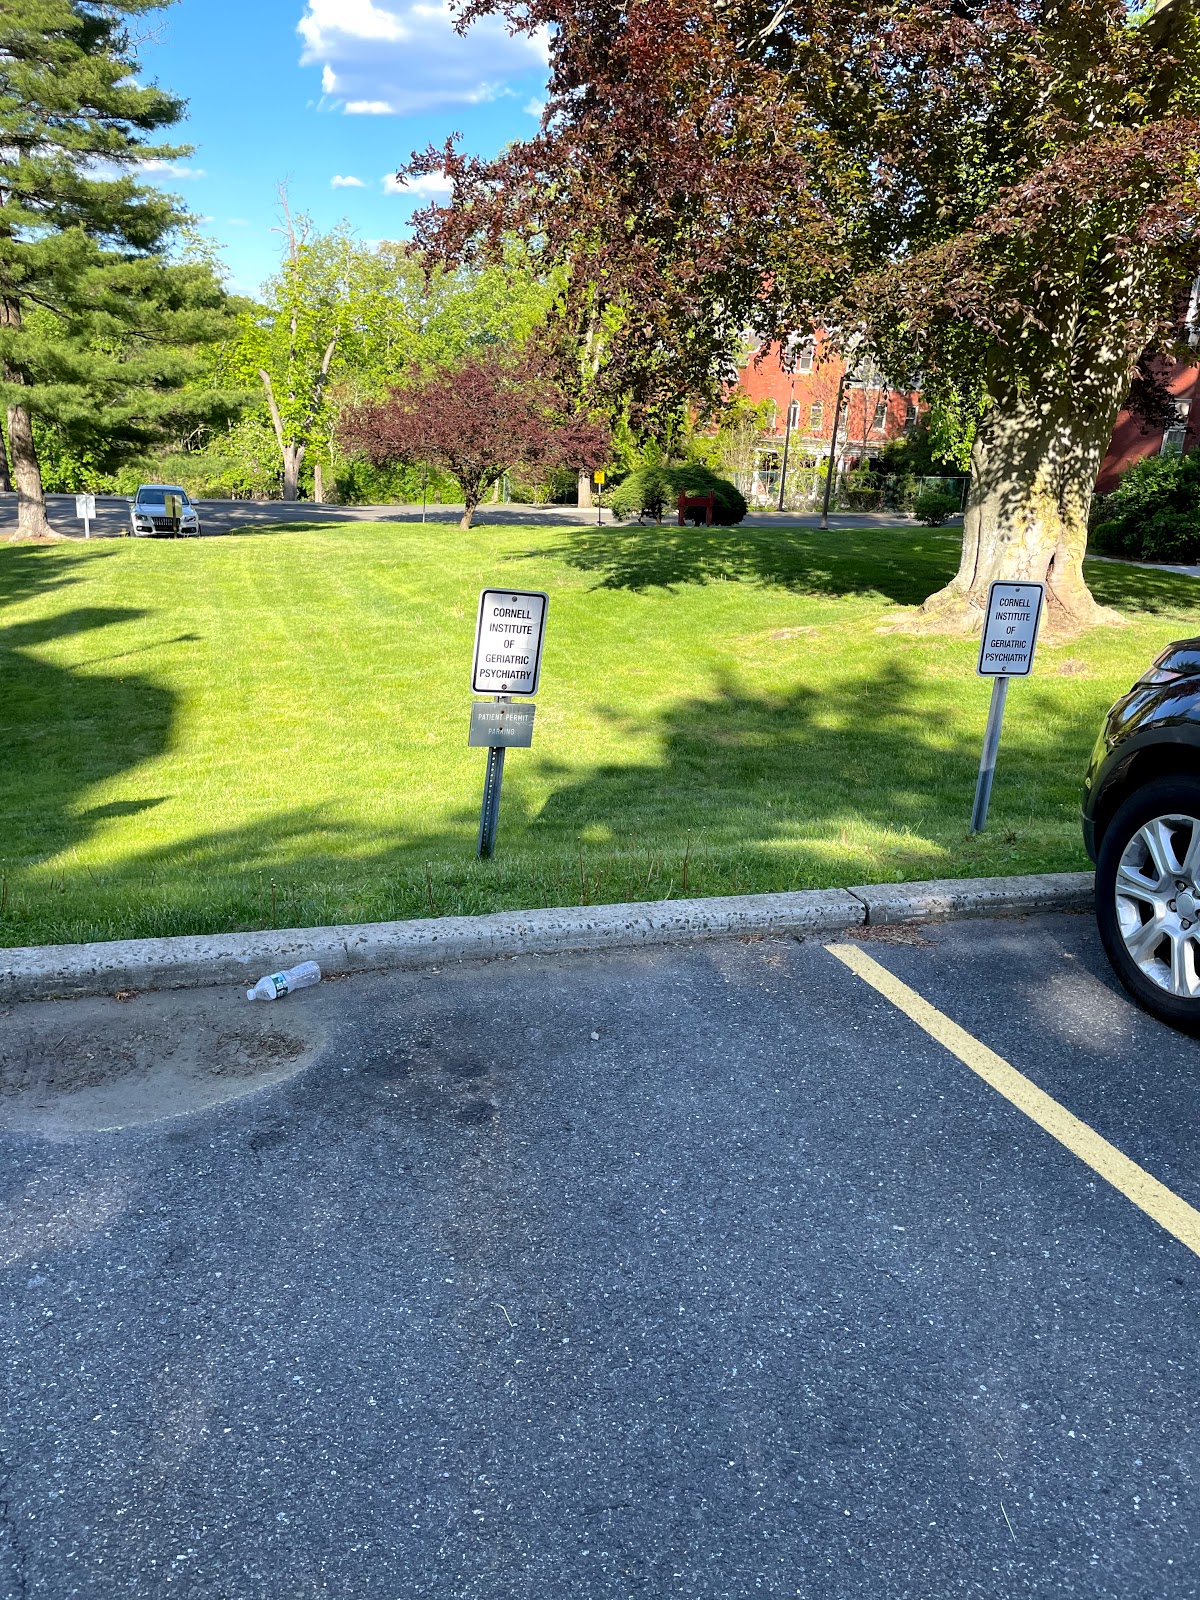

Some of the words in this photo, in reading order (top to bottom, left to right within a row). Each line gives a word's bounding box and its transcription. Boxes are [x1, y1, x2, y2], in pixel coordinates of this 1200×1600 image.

[999, 598, 1031, 607] CORNELL
[493, 607, 532, 620] CORNELL
[995, 612, 1031, 621] INSTITUTE
[489, 623, 533, 635] INSTITUTE
[1006, 626, 1016, 635] OF
[503, 639, 515, 649] OF
[990, 639, 1027, 649] GERIATRIC
[485, 654, 530, 665] GERIATRIC
[985, 653, 1028, 662] PSYCHIATRY
[479, 668, 532, 680] PSYCHIATRY
[478, 713, 503, 721] PATIENT
[505, 714, 529, 722] PERMIT
[488, 728, 515, 736] PARKING
